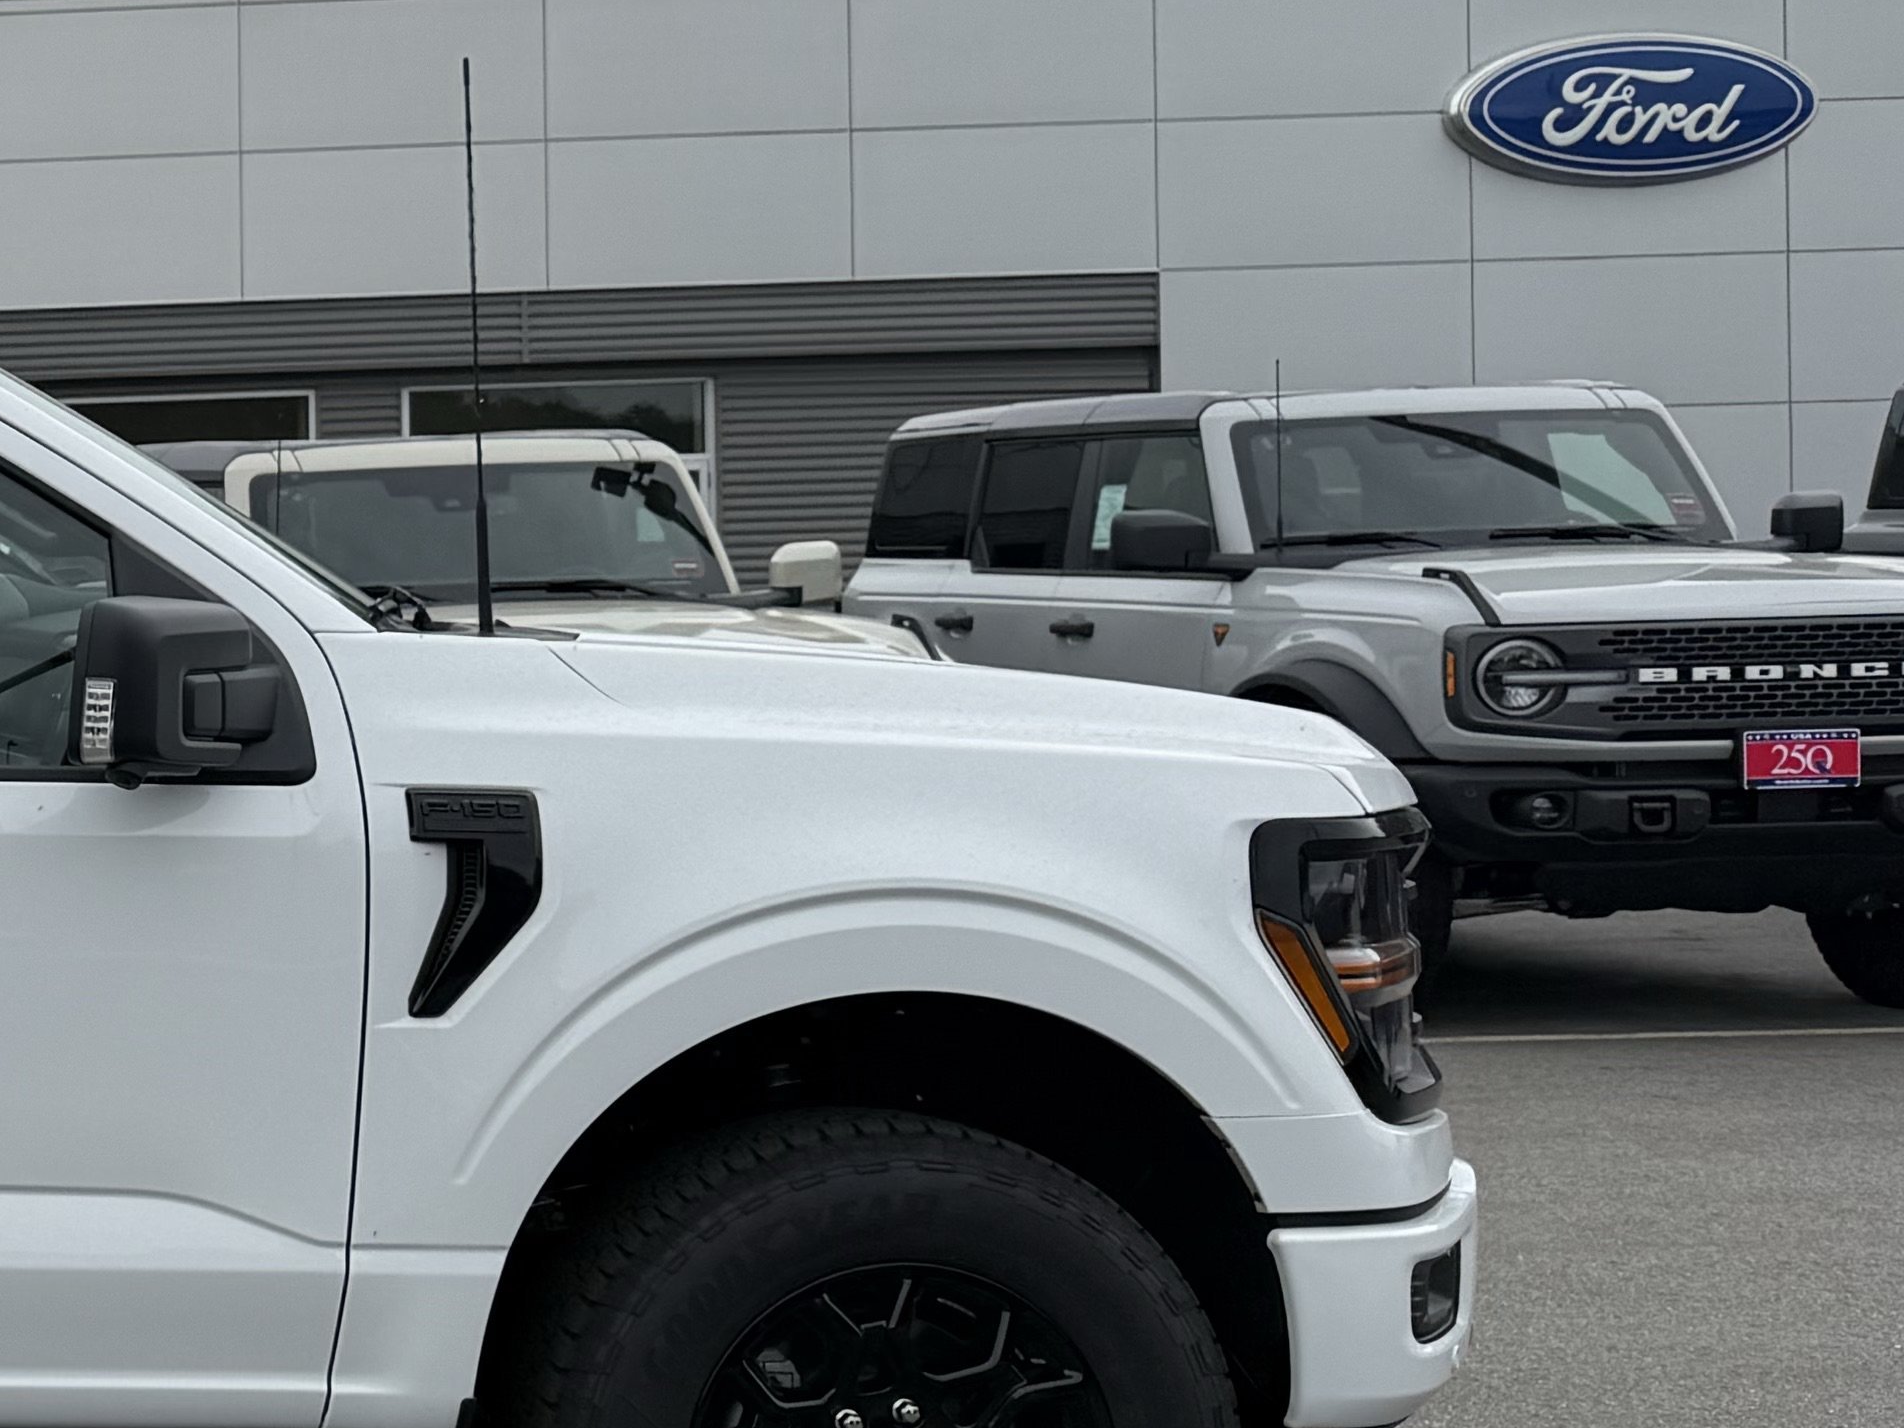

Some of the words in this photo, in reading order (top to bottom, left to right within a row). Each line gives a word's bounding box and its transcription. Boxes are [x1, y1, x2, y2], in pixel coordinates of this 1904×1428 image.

[1541, 66, 1745, 147] Ford
[1638, 661, 1904, 683] BRONC
[419, 798, 527, 820] F-150
